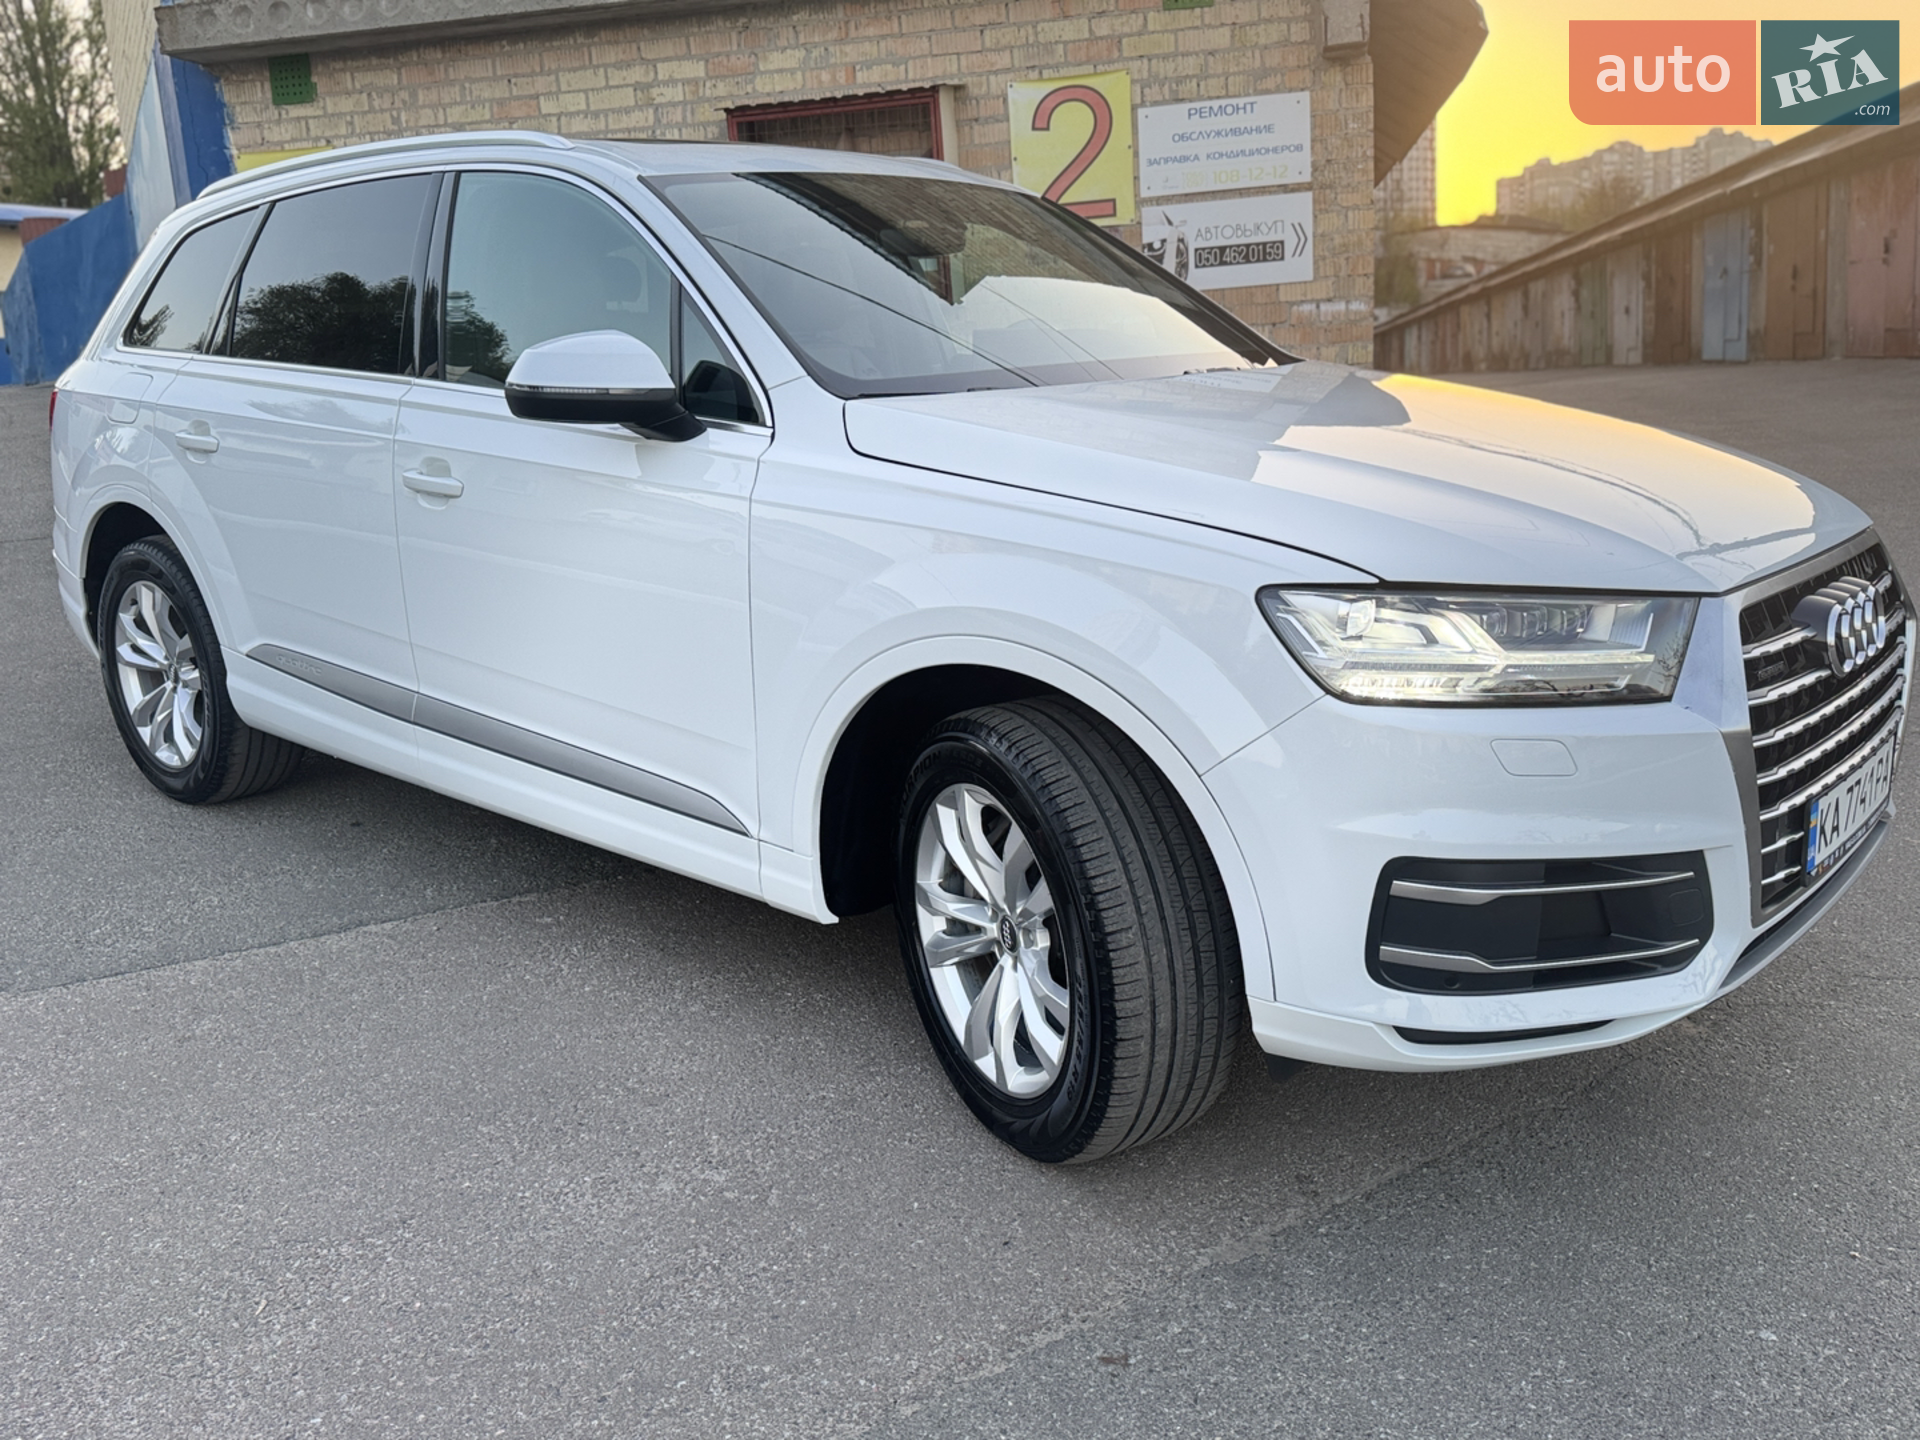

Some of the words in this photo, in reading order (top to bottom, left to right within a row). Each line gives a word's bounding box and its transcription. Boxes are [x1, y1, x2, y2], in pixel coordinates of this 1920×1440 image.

[1187, 101, 1258, 120] РЕМОНТ
[1171, 123, 1275, 143] ОБСЛУЖИВАНИЕ
[1031, 84, 1117, 218] 2
[1146, 153, 1200, 167] ЗАПРАВКА
[1206, 143, 1304, 161] КОНДИЦИОНЕРОВ
[1212, 165, 1289, 185] 108-12-12
[1194, 219, 1285, 242] АВТОВЫКУП
[1196, 248, 1220, 267] 050
[1222, 246, 1247, 265] 462
[1817, 796, 1840, 854] KA
